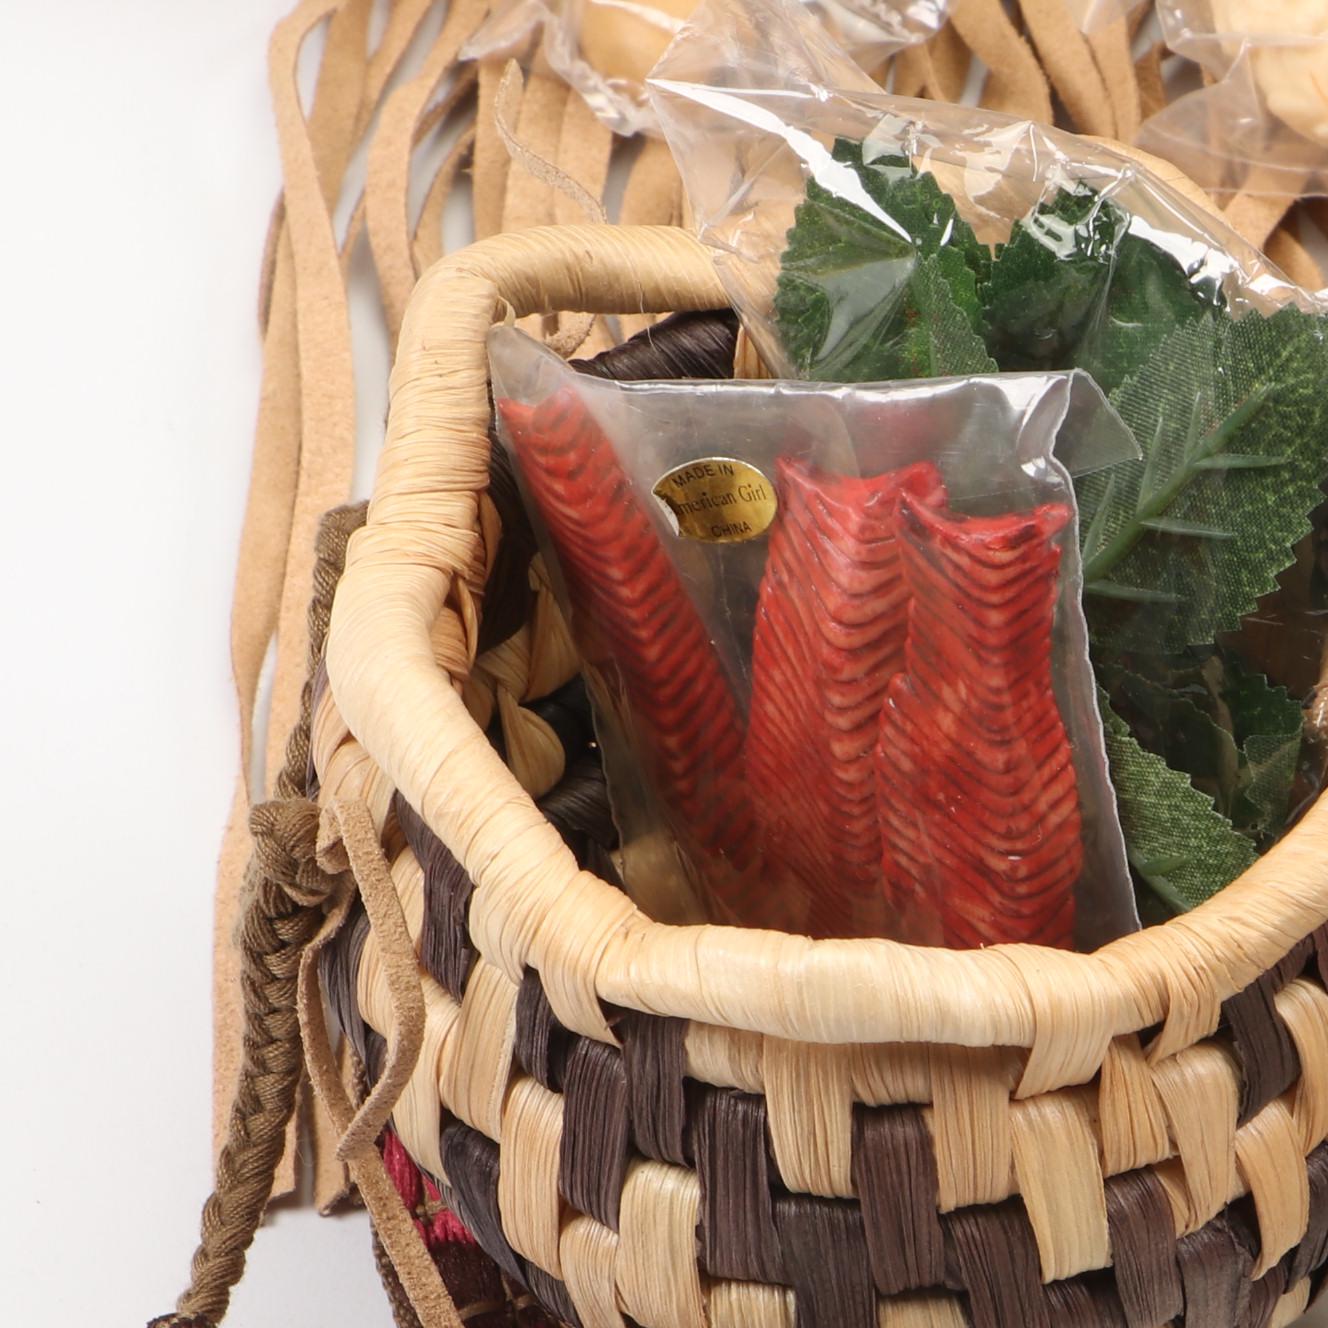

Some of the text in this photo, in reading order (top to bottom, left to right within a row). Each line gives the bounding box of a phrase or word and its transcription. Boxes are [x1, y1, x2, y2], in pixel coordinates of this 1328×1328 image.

[672, 463, 735, 488] MADE IN
[674, 484, 767, 516] merican Girl
[711, 521, 752, 537] CHINA
